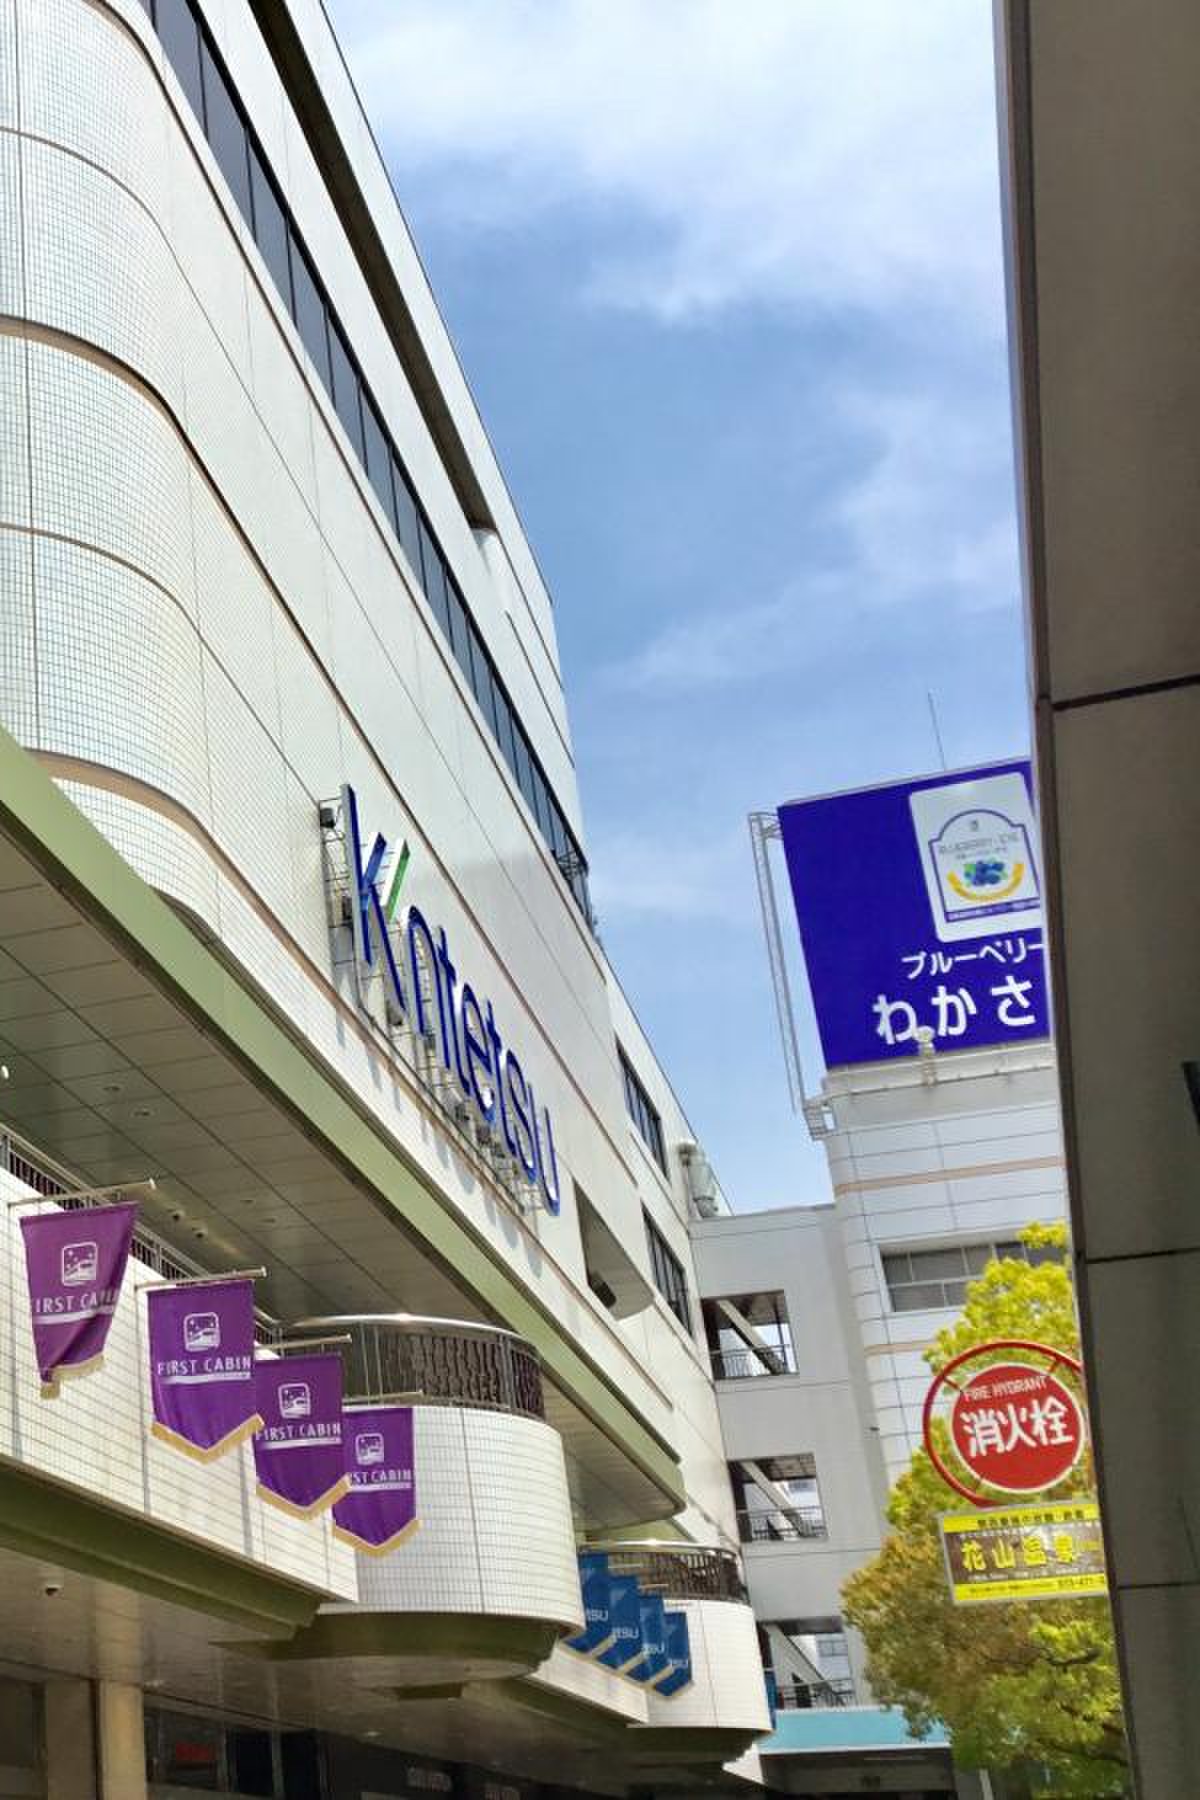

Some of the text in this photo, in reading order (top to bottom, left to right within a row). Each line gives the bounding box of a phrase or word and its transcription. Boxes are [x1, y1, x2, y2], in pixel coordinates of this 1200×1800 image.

[872, 976, 1036, 1045] わかさ
[35, 1295, 75, 1313] IRST
[157, 1359, 197, 1376] FIRST
[203, 1356, 251, 1372] CABIN
[300, 1423, 341, 1438] CABIN
[960, 1396, 1075, 1458] 消火栓
[371, 1469, 411, 1484] CABIN
